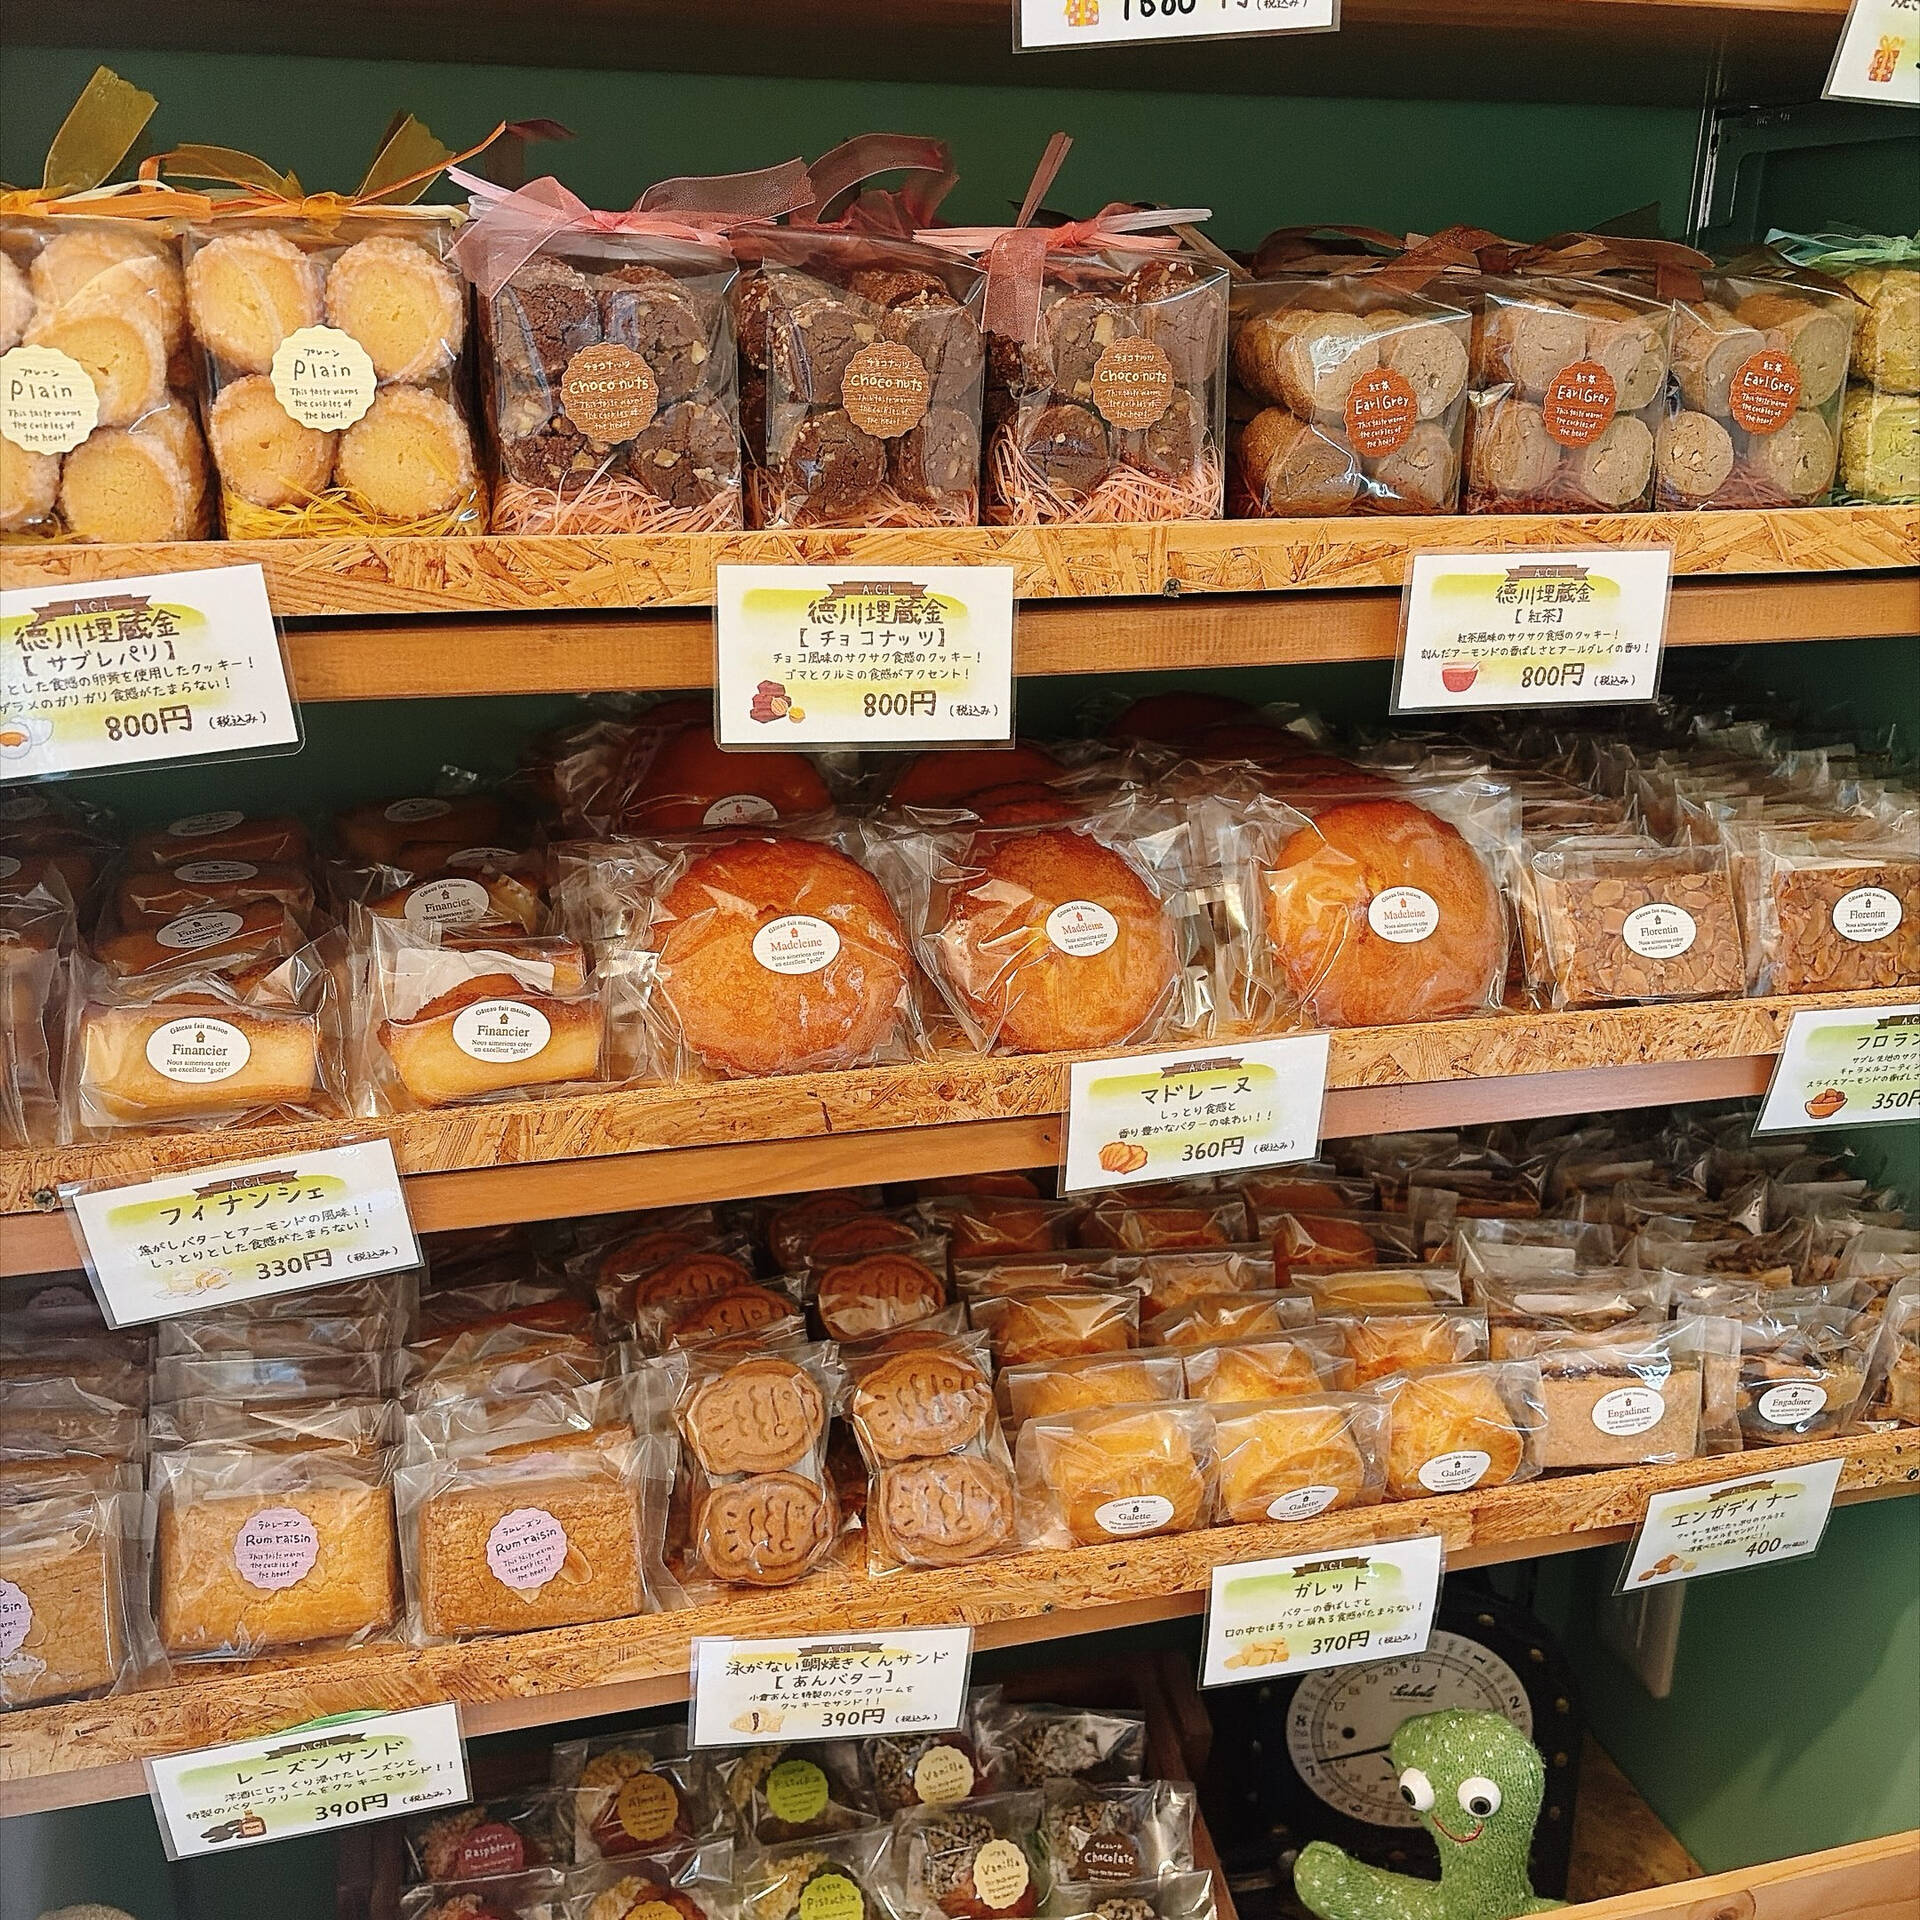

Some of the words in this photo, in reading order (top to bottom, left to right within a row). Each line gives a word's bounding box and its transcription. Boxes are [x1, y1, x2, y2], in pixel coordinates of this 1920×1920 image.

[294, 359, 350, 380] Plain
[12, 380, 72, 401] Plain
[290, 388, 307, 396] This
[1744, 371, 1769, 387] Earl
[1771, 378, 1795, 395] Grey
[1355, 397, 1380, 415] Earl
[1382, 395, 1408, 409] Grey
[1557, 385, 1583, 400] Earl
[1584, 389, 1609, 405] Grey
[1495, 582, 1595, 605] 徳川埋蔵金
[807, 598, 948, 627] 徳川埋蔵金
[1515, 607, 1563, 624] 【紅茶】
[14, 608, 181, 652] 徳川埋蔵金
[799, 628, 945, 648] 【チョコナッツ】
[1458, 629, 1619, 644] 紅茶風味のサクサク食感のクッキー！
[23, 640, 176, 678] 【サブレパリ】
[772, 651, 982, 664] チョコ風味のサクサク食感のクッキー！
[0, 657, 254, 697] とした食感の卵黄を使用したクッキー！
[785, 668, 970, 681] ゴマとクルミの食感がアクセント！
[1522, 663, 1585, 688] 800円
[864, 690, 937, 717] 800円
[105, 704, 193, 742] 800円
[1384, 909, 1426, 920] Madeleine
[1850, 910, 1885, 919] Florentin
[1062, 922, 1104, 934] Madeleine
[1641, 925, 1678, 936] Florentin
[770, 938, 822, 952] Madeleine
[477, 1025, 530, 1037] Financier
[172, 1044, 228, 1055] Financier
[1161, 1102, 1236, 1120] しっとり食感と
[1182, 1136, 1244, 1162] 360円
[160, 1186, 325, 1226] フィナンシェ
[257, 1248, 332, 1280] 330円
[1608, 1406, 1650, 1418] Engadiner
[1772, 1398, 1812, 1407] Engadiner
[1441, 1468, 1471, 1477] Galette
[1289, 1501, 1318, 1510] Galette
[1672, 1493, 1798, 1527] エンガディナー
[259, 1520, 300, 1530] ラムレーズン
[246, 1535, 272, 1546] Rum
[276, 1534, 310, 1543] raisin
[496, 1540, 520, 1556] Rum
[523, 1528, 556, 1544] raisin
[1295, 1575, 1367, 1598] ガレット
[1283, 1598, 1370, 1617] バターの香ばしさと
[1311, 1630, 1370, 1655] 370円
[775, 1670, 893, 1689] 【あんバター】
[822, 1708, 885, 1728] 390円
[237, 1740, 404, 1786] レーズンサンド
[315, 1792, 389, 1821] 390円
[1084, 1852, 1134, 1864] Chocolate
